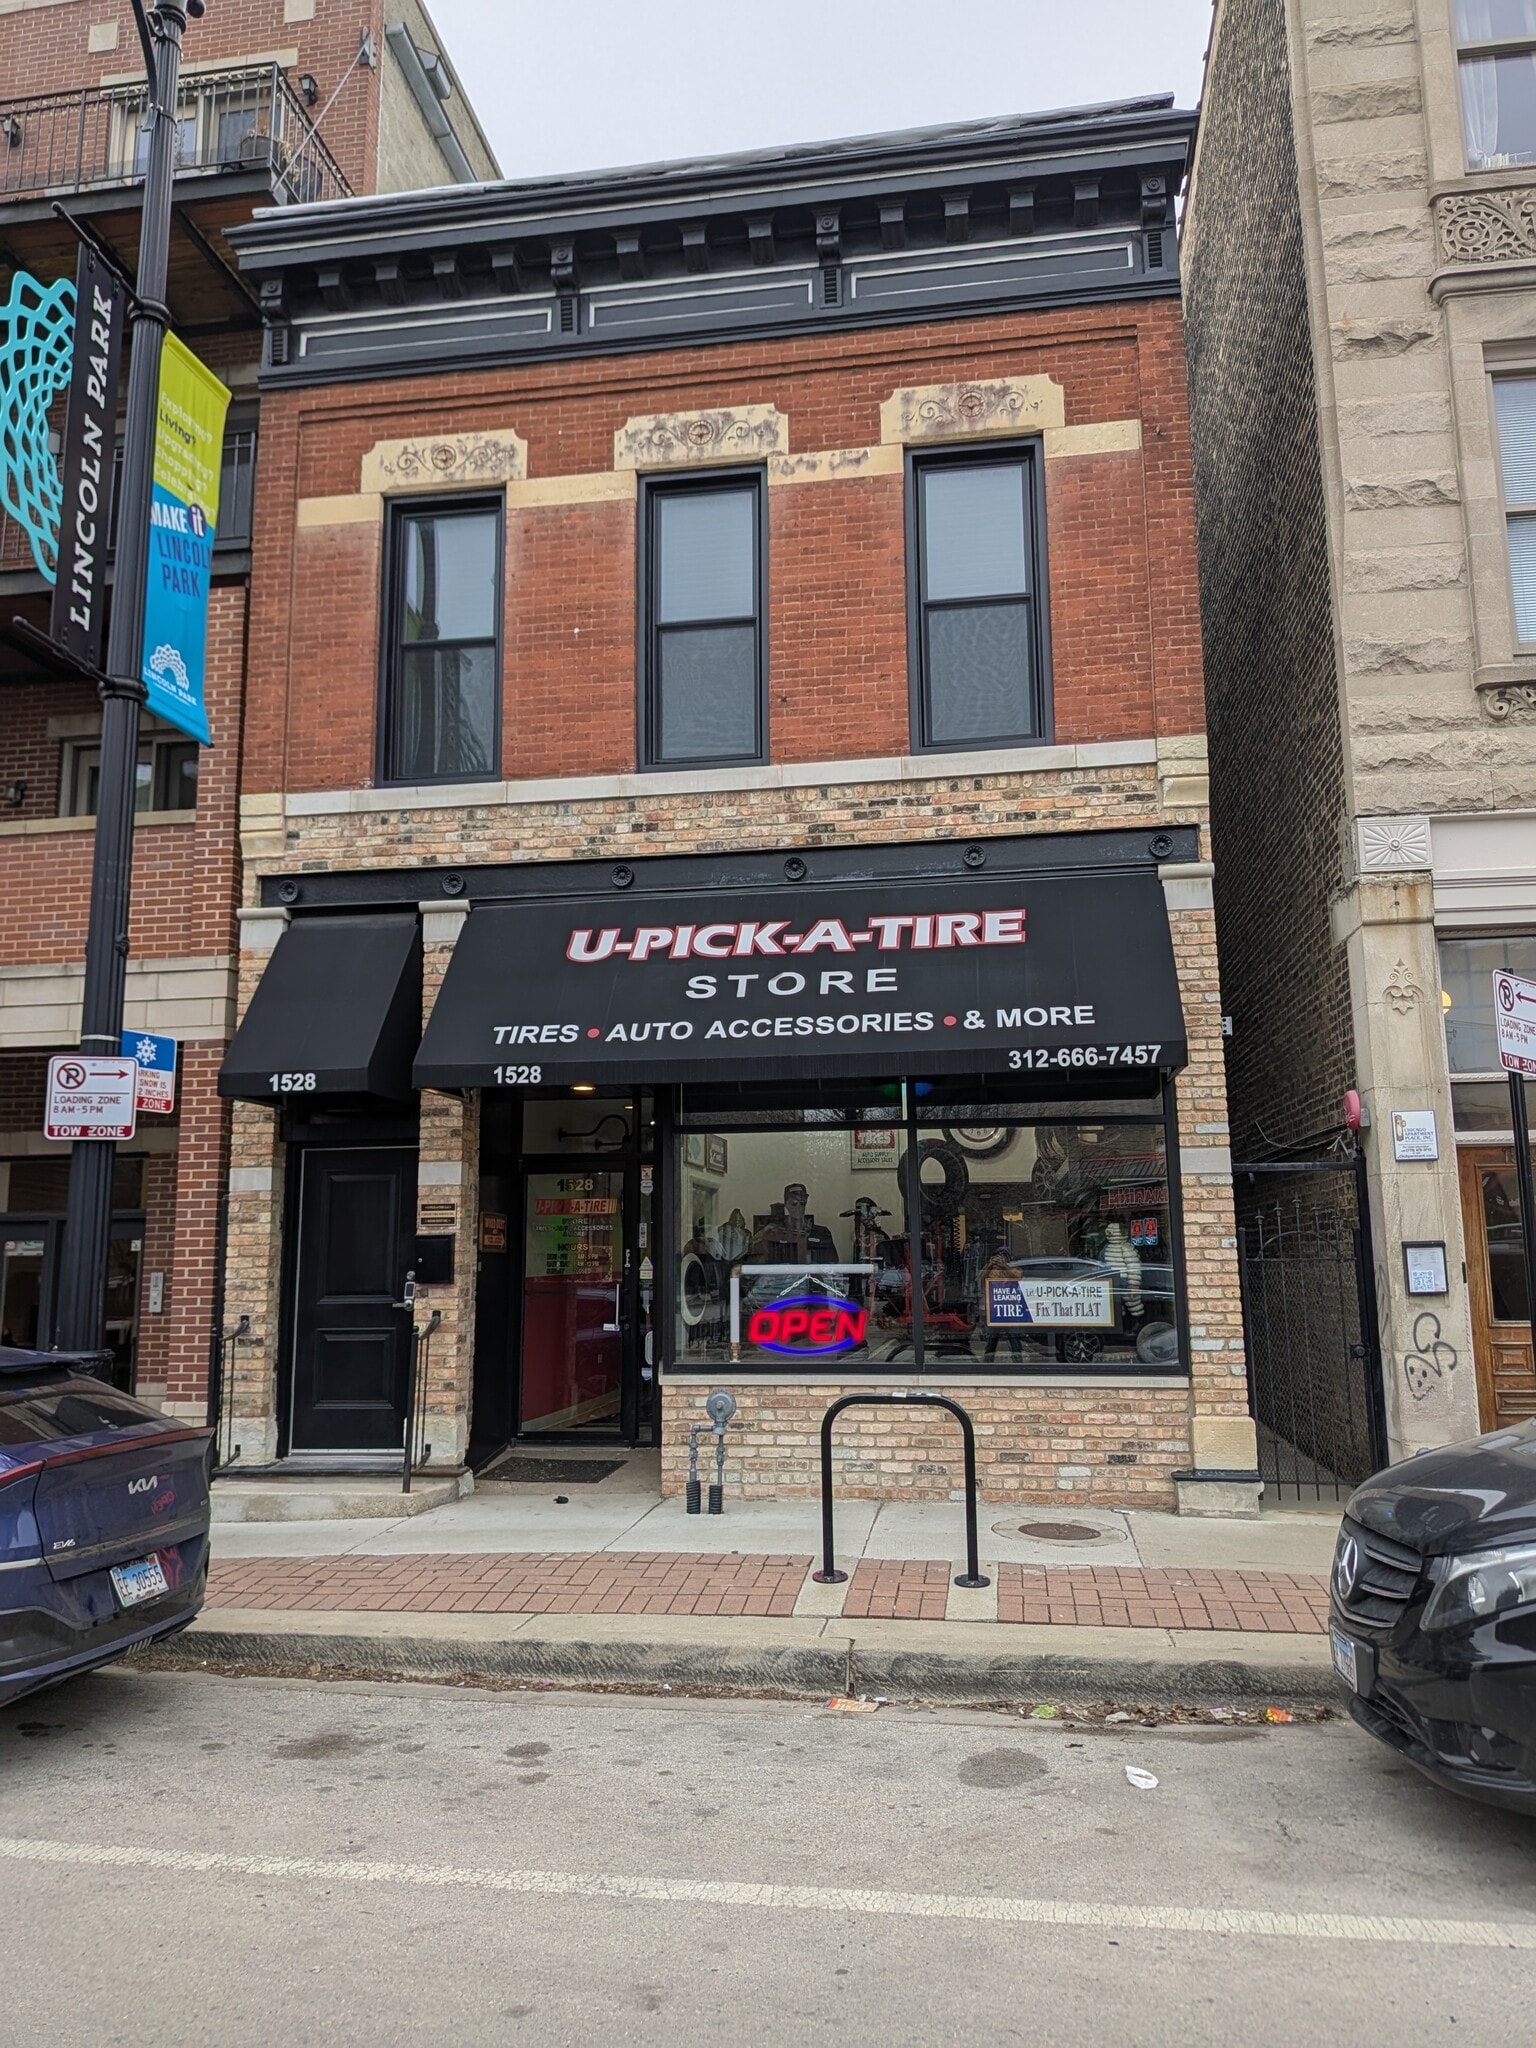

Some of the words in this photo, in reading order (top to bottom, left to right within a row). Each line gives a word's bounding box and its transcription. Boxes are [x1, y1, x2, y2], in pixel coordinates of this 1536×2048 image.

[70, 413, 103, 632] LINCOLN
[87, 285, 112, 410] PARK
[150, 501, 188, 534] MAKE
[191, 505, 205, 537] it
[161, 563, 201, 598] PARK
[566, 908, 1027, 962] U-PICK-A-TIRE
[685, 968, 898, 999] STORE
[493, 1024, 580, 1044] TIRES
[605, 1021, 694, 1042] AUTO
[704, 1011, 934, 1040] ACCESSORIES
[963, 1010, 986, 1030] &
[996, 1005, 1096, 1028] MORE
[1500, 1017, 1521, 1031] LOADING
[1008, 1044, 1162, 1069] 312-666-7457
[1503, 1053, 1520, 1069] TOW
[269, 1072, 317, 1092] 1528
[493, 1065, 542, 1084] 1528
[54, 1096, 93, 1104] LOADING
[98, 1096, 121, 1104] ZONE
[142, 1099, 167, 1110] ZONE
[52, 1126, 81, 1136] TOW
[88, 1126, 125, 1136] ZONE
[557, 1179, 594, 1192] 1528
[1036, 1286, 1103, 1298] U-PICK-A-TIRE
[994, 1304, 1024, 1317] TIRE
[1036, 1303, 1050, 1316] Fix
[1052, 1302, 1074, 1316] That
[1075, 1302, 1101, 1317] FLAT
[748, 1309, 868, 1344] OPEN
[53, 1538, 76, 1550] EV6
[117, 1577, 133, 1598] EE
[132, 1565, 163, 1592] 30555
